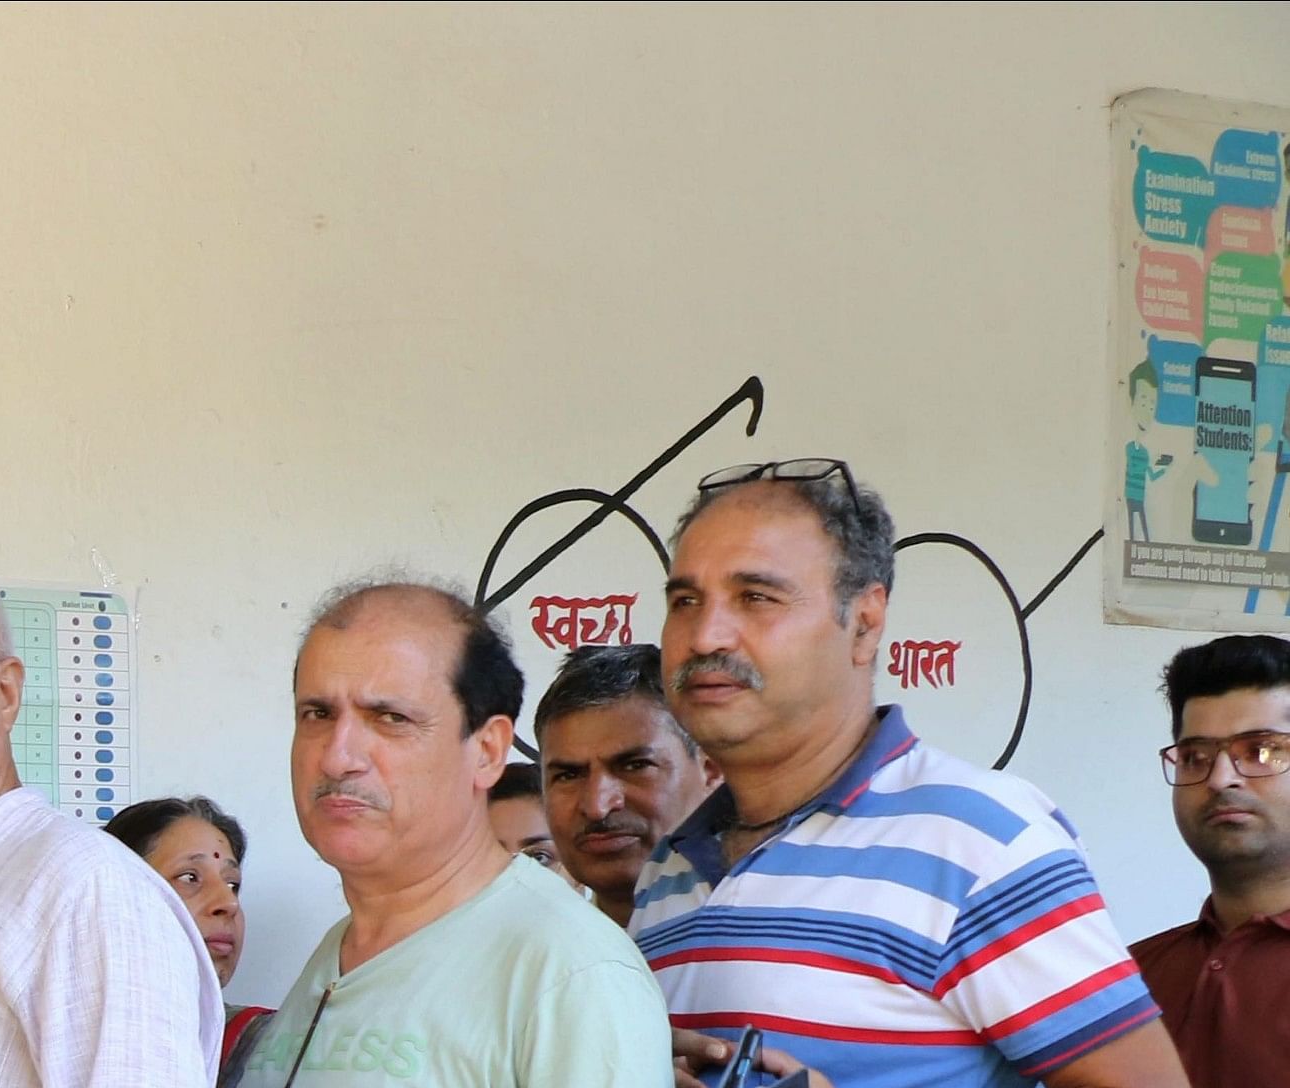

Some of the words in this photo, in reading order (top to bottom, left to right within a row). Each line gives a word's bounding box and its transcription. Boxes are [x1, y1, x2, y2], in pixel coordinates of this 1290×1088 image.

[1145, 169, 1215, 197] Examination
[1145, 191, 1182, 214] Stress
[1144, 214, 1187, 239] Anxiety
[1196, 400, 1252, 428] Attention
[887, 639, 963, 689] भारत
